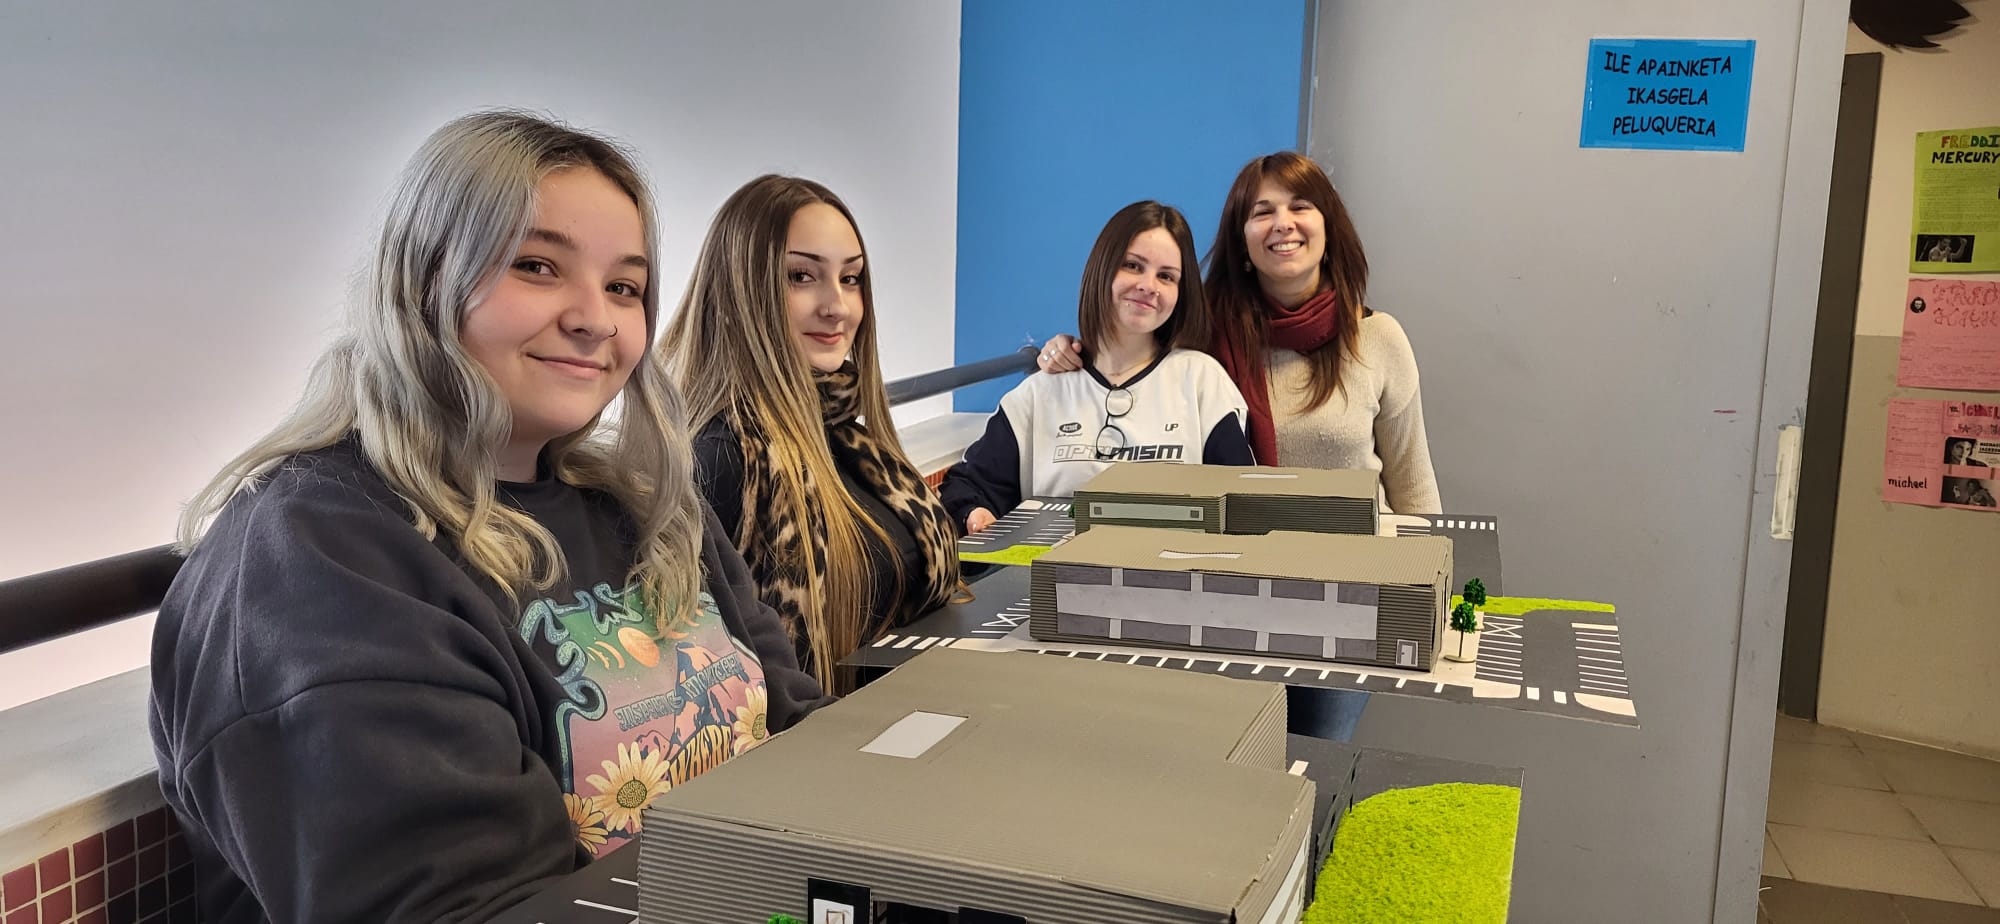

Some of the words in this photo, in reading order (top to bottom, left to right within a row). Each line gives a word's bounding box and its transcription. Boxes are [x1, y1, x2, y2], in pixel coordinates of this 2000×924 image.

[1603, 51, 1631, 74] ILE
[1636, 56, 1732, 77] APAINKETA
[1626, 87, 1708, 105] IKASGELA
[1612, 115, 1716, 137] PELUQUERIA
[1931, 151, 2000, 164] MERCURY
[1164, 423, 1179, 432] UP
